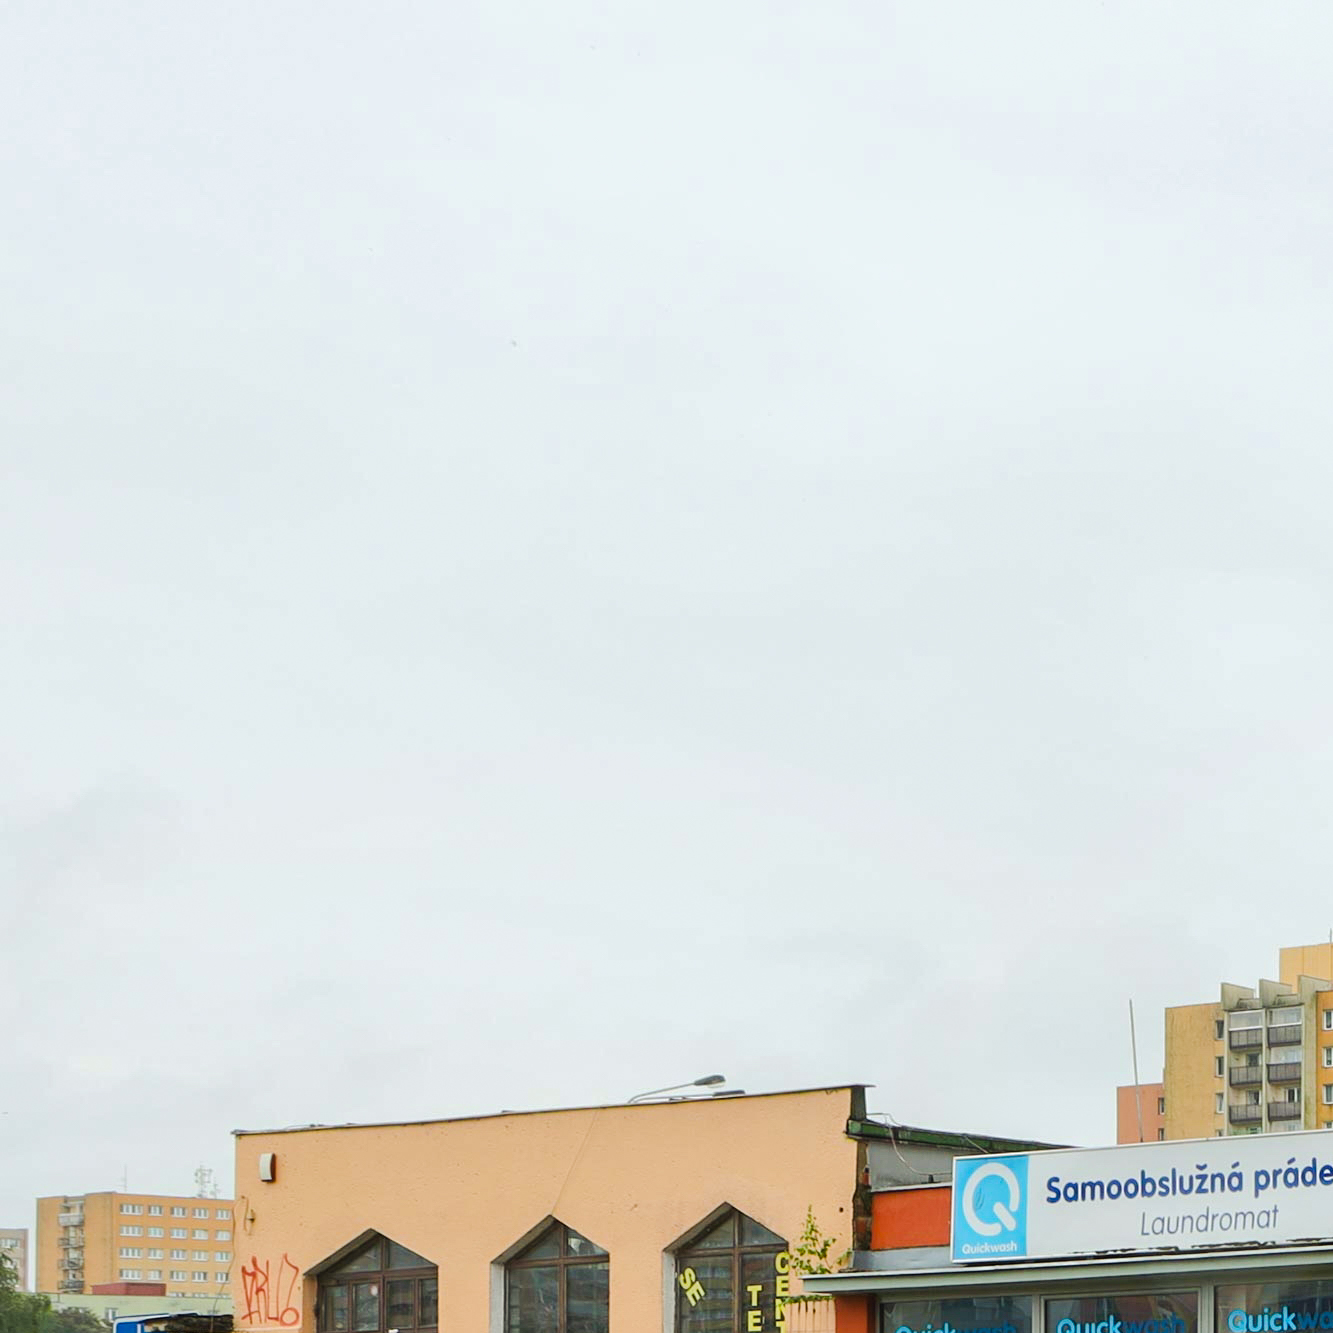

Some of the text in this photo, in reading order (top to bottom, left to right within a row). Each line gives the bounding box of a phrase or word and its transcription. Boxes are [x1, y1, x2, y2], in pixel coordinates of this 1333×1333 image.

[1046, 1161, 1244, 1204] Samoobslužná
[1141, 1204, 1280, 1236] Laundromat
[961, 1241, 1018, 1255] Quickwash
